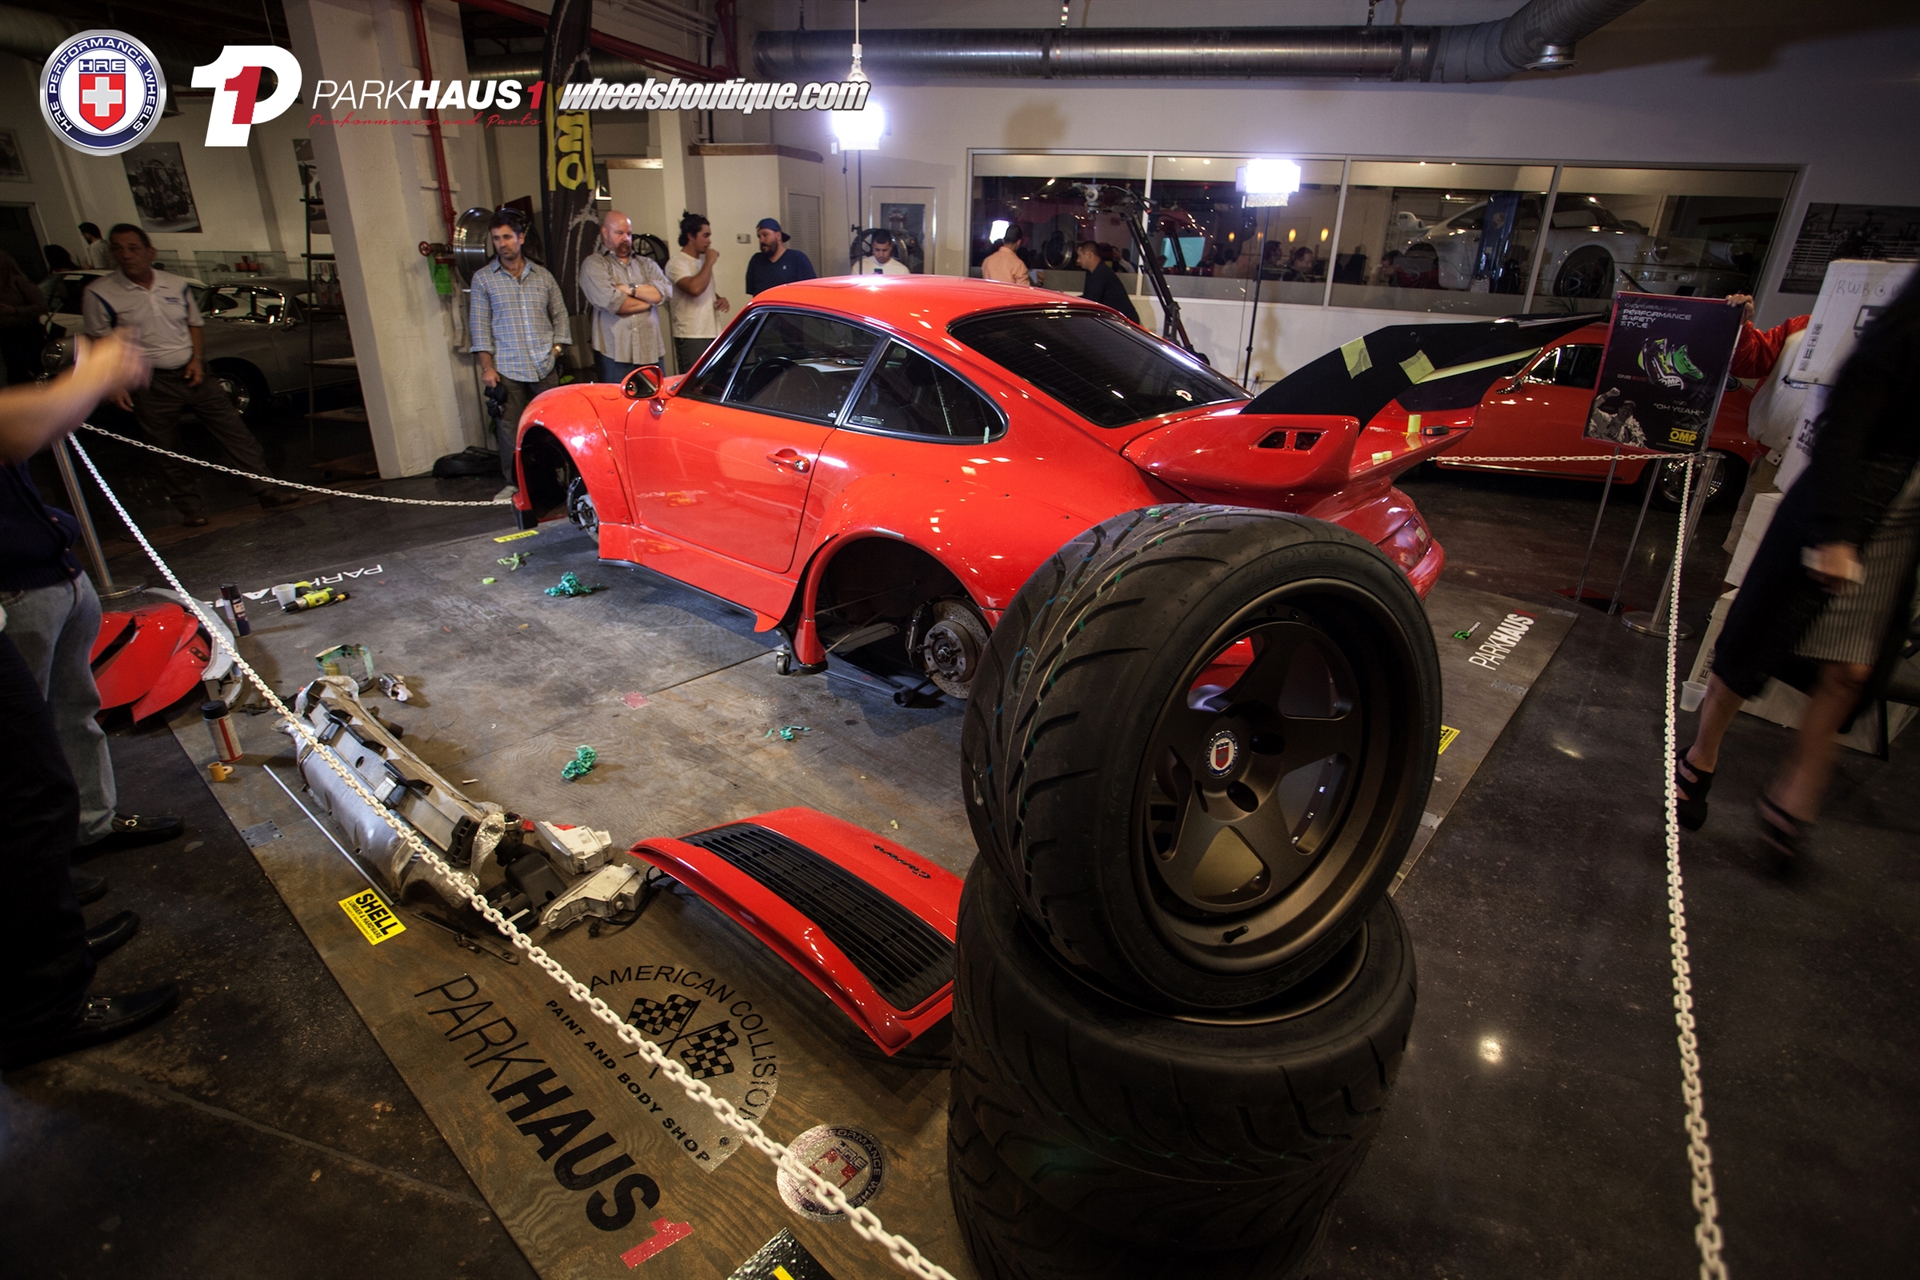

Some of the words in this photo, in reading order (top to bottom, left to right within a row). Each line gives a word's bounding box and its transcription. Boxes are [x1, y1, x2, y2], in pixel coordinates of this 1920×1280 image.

[555, 84, 586, 191] OM
[1619, 320, 1649, 329] STYLE
[1621, 315, 1657, 323] SAFETY
[1622, 308, 1692, 321] PERFORMANCE
[1669, 430, 1698, 444] OMP
[355, 893, 398, 936] SHELL
[590, 965, 736, 1003] AMERICAN
[729, 1000, 778, 1121] COLLISION
[545, 1000, 586, 1036] PAINT
[584, 1041, 617, 1070] AND
[617, 1072, 663, 1114] BODY
[662, 1117, 711, 1162] SHOP
